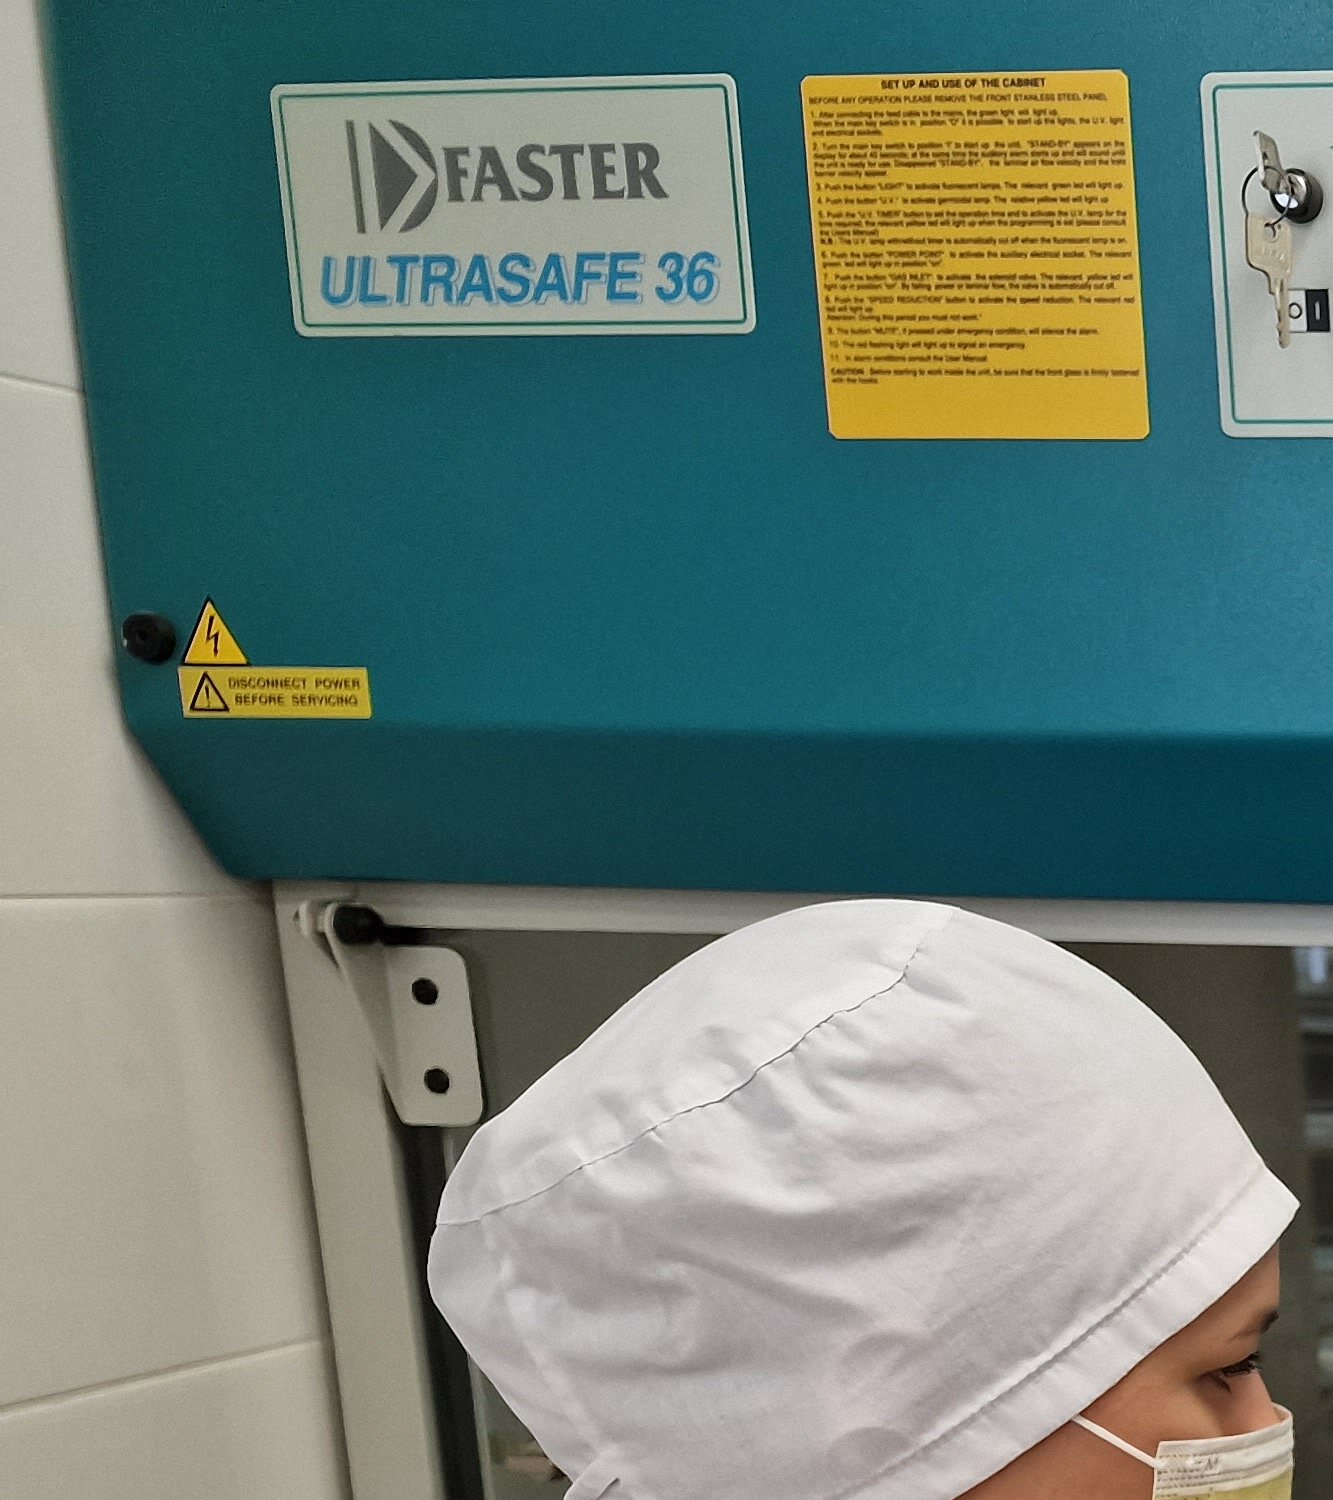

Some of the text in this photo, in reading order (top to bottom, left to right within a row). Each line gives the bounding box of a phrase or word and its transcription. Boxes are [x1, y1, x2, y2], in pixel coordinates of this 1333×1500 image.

[901, 79, 916, 89] UP
[917, 79, 940, 88] AND
[941, 79, 962, 88] USE
[963, 78, 978, 88] OF
[980, 78, 1000, 88] THE
[443, 142, 669, 203] FASTER
[319, 250, 722, 306] ULTRASAFE 36
[228, 677, 360, 690] DISCONNECT POWER
[235, 694, 359, 706] BEFORE SERVICING
